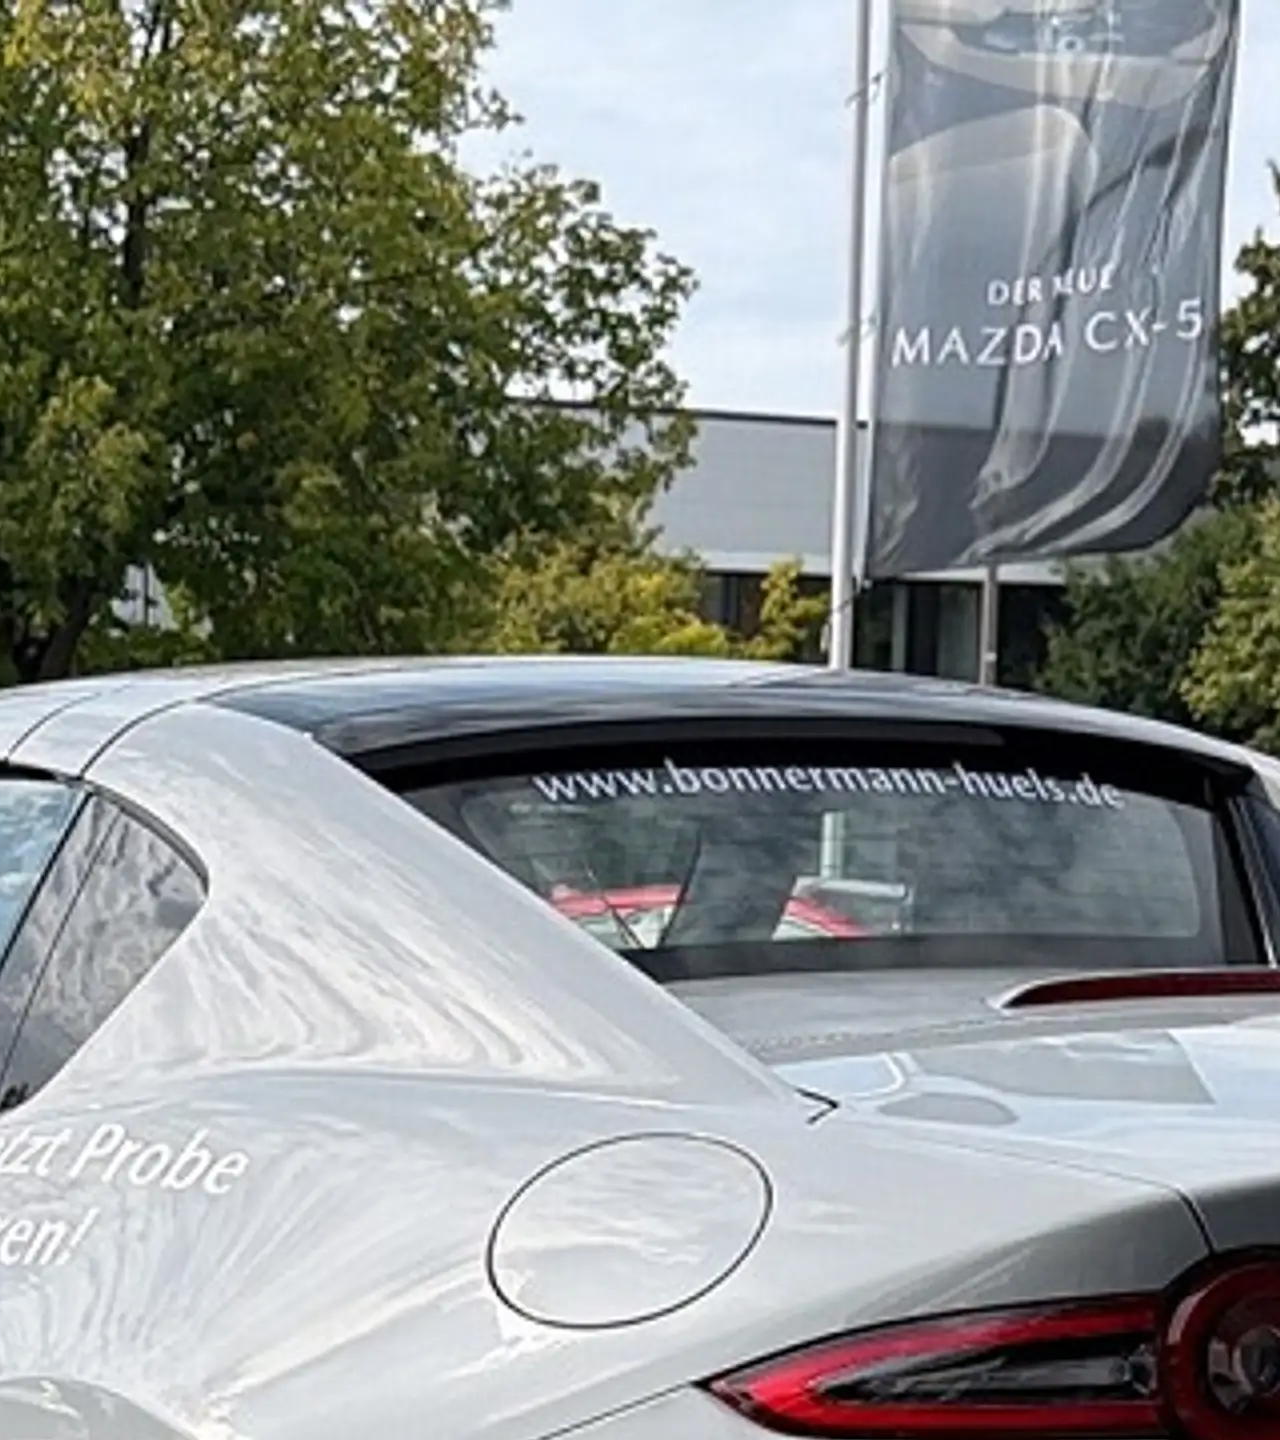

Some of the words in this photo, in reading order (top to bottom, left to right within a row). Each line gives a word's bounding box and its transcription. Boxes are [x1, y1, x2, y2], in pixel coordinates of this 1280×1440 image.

[891, 320, 1064, 368] MAZDA
[1083, 296, 1204, 353] CX-5
[532, 759, 1124, 809] www.bonnermann-huels.de
[68, 1122, 250, 1196] Probe
